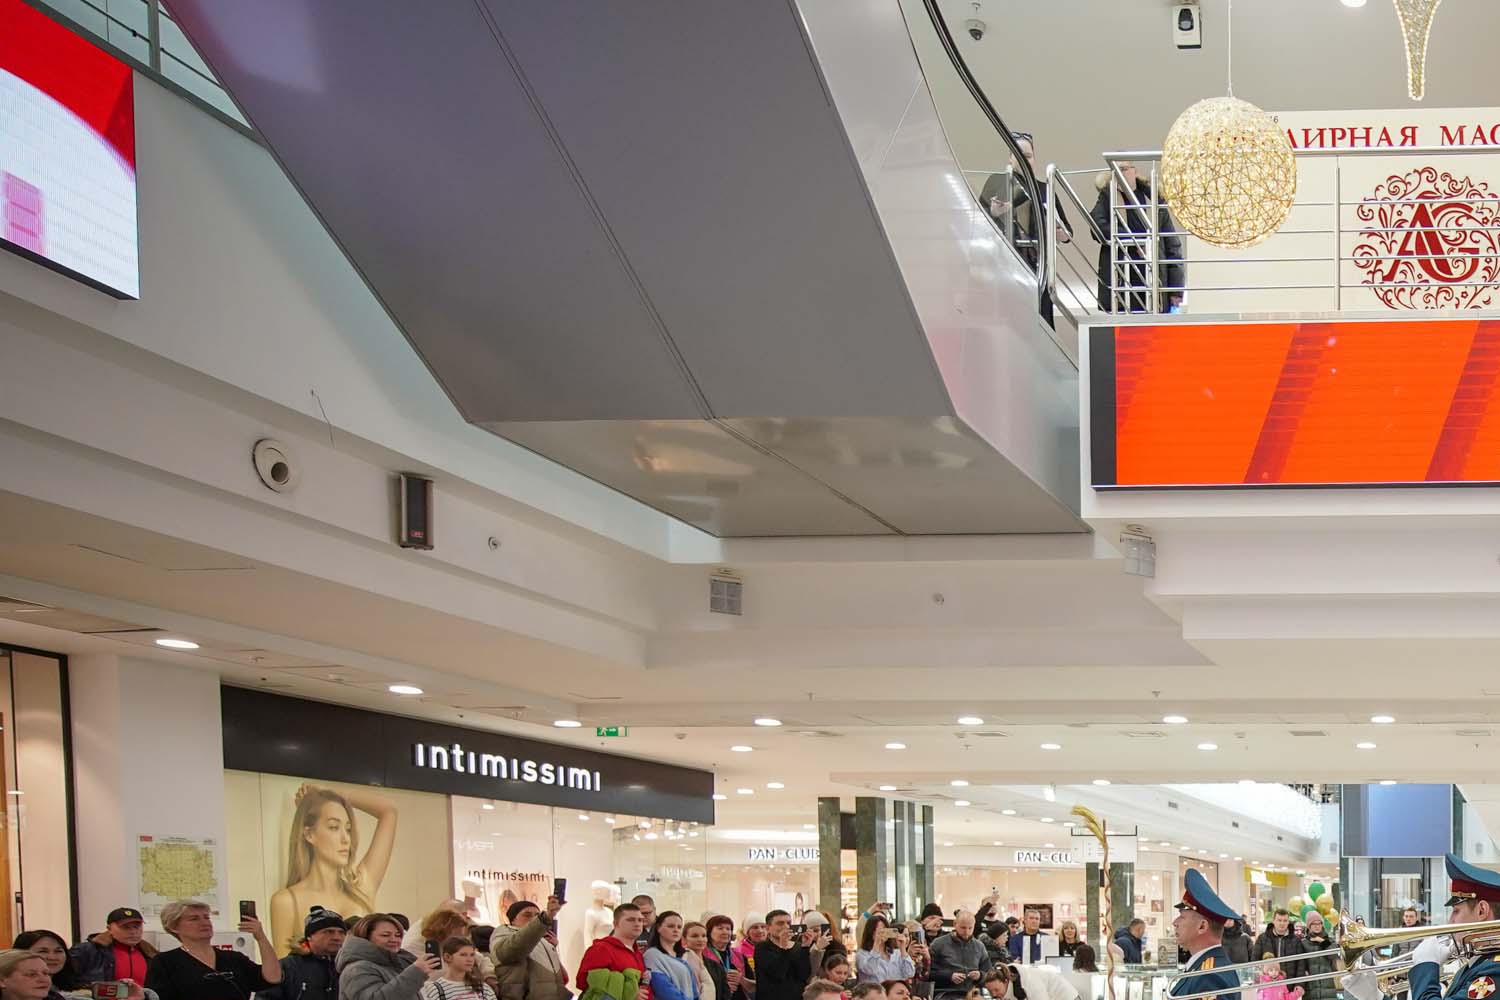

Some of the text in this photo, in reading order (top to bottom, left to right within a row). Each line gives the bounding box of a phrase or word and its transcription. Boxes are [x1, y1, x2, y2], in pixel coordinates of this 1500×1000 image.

[414, 743, 600, 791] intimissimi
[748, 848, 775, 860] PAN
[1016, 851, 1042, 863] PAN
[1051, 852, 1074, 864] CLU
[468, 868, 545, 882] intimissimi
